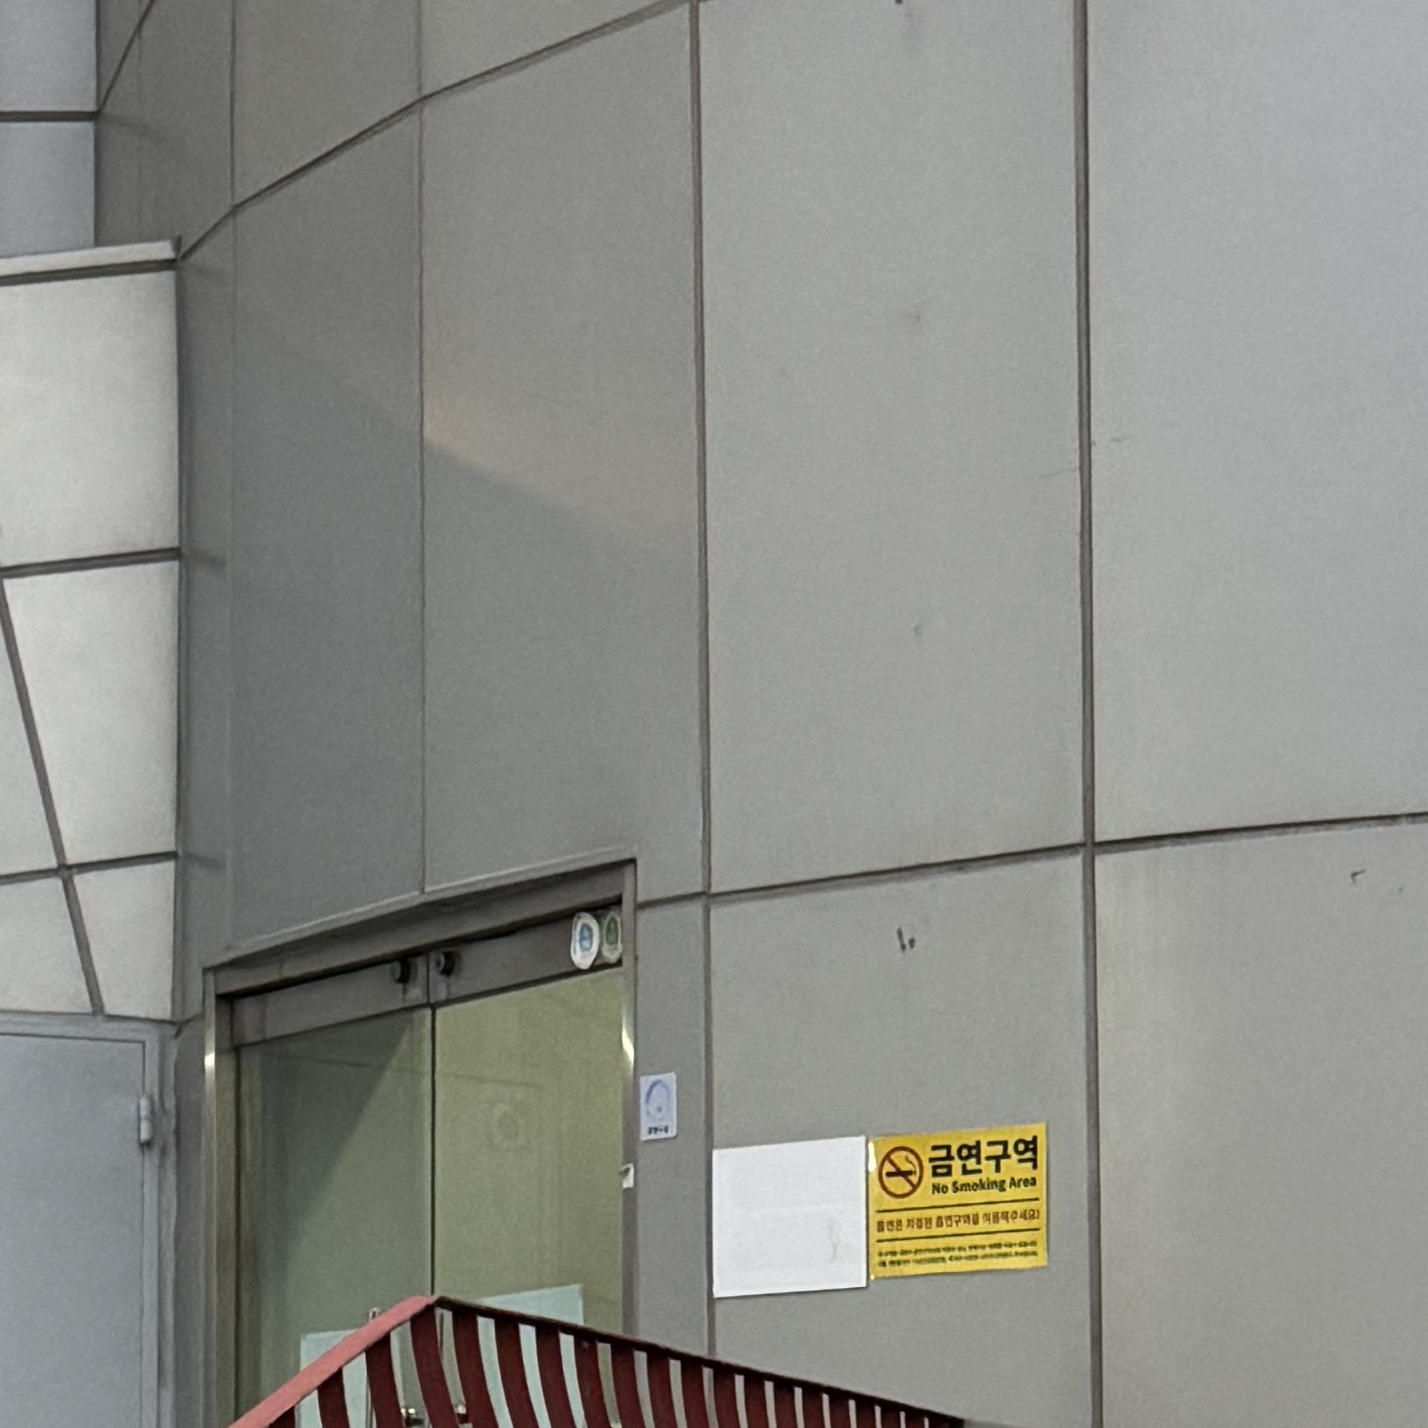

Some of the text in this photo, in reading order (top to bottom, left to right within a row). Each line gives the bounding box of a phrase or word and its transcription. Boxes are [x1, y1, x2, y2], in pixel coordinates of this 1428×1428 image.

[928, 1135, 1038, 1177] 금연구역
[931, 1176, 1037, 1195] No Smoking Area
